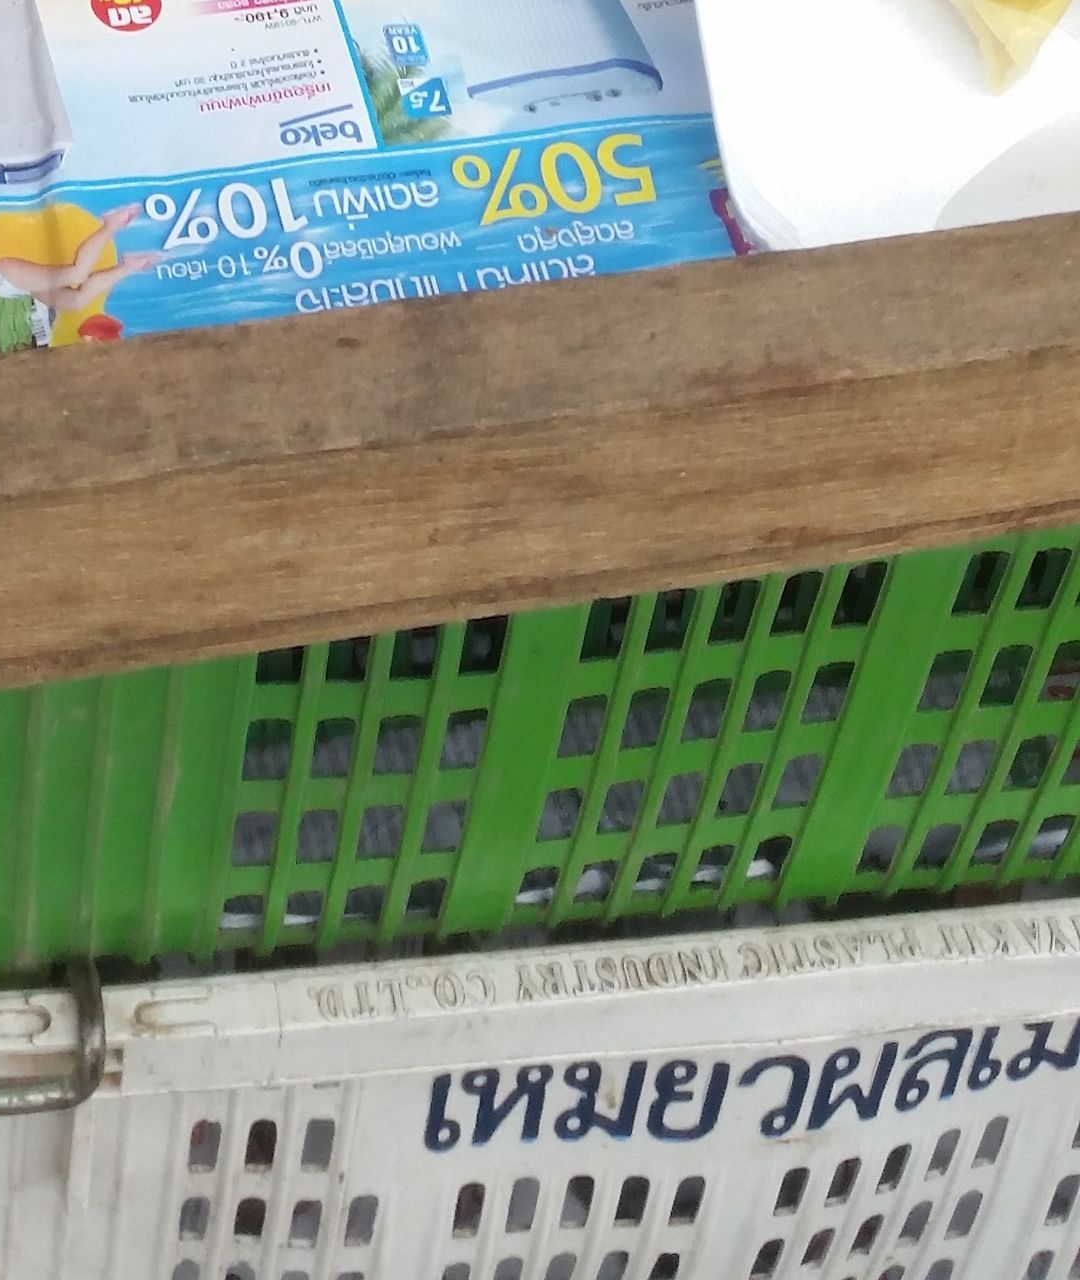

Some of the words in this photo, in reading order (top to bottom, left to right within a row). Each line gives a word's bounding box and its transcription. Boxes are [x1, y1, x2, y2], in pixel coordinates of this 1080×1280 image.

[106, 4, 153, 28] ลด
[391, 35, 421, 56] 10
[408, 88, 447, 114] 7.5
[279, 120, 363, 148] beko
[451, 132, 657, 226] 50%
[142, 176, 308, 251] 10%
[313, 179, 440, 231] ลดเพิ่ม
[516, 219, 634, 254] ลดสูงสุด
[156, 259, 208, 282] เดือน
[737, 927, 923, 980] PLASTIC
[514, 946, 729, 1004] INDUSTRY
